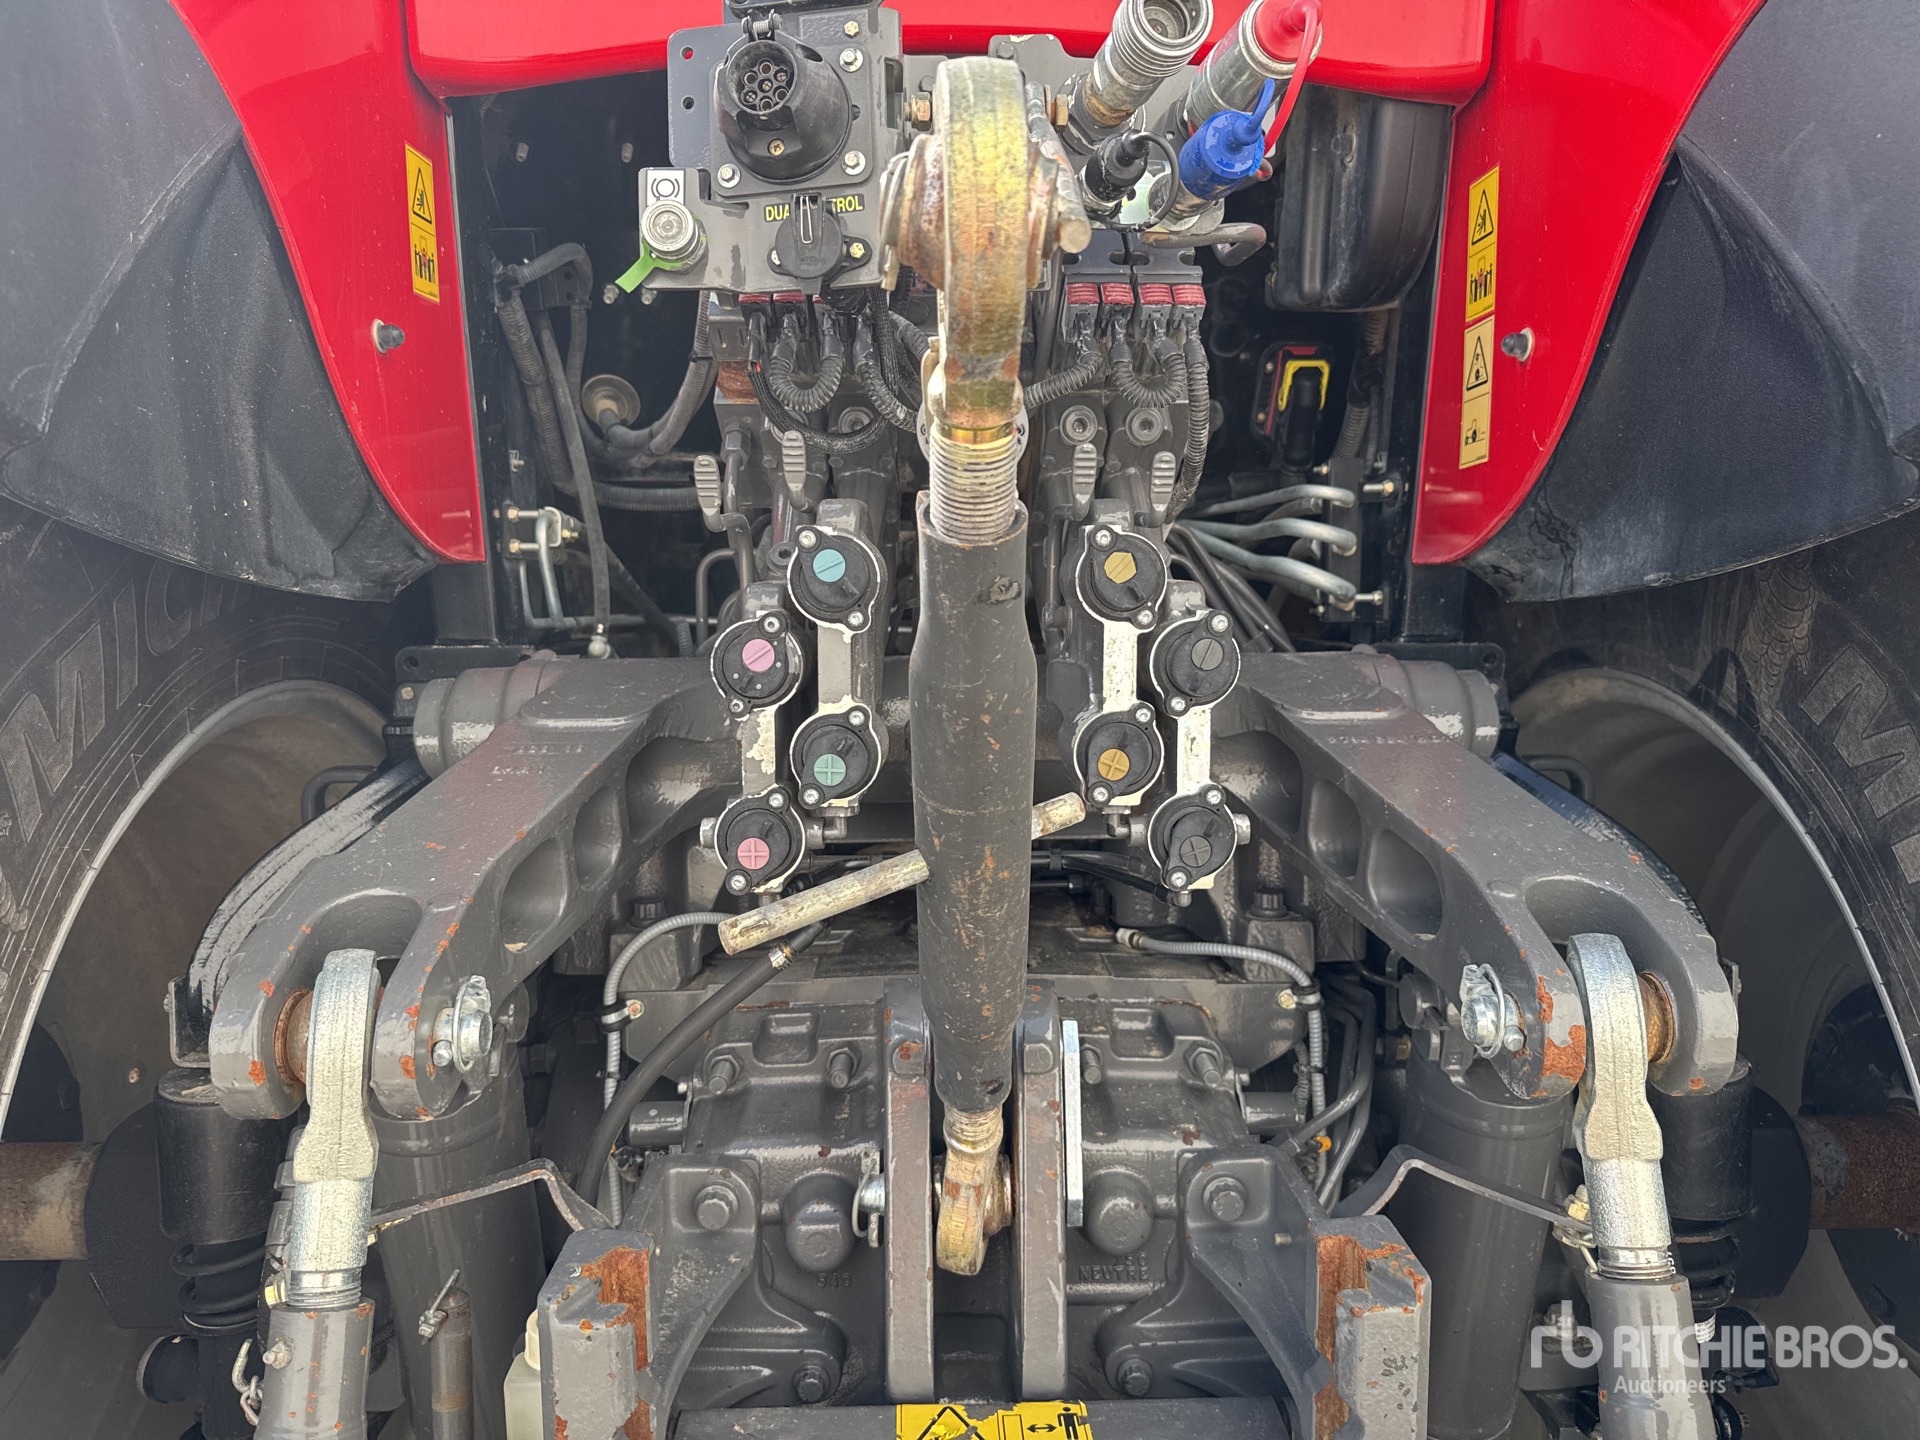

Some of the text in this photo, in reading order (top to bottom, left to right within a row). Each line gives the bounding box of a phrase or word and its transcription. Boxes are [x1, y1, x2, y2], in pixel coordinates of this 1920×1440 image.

[765, 195, 863, 221] DUA TROL
[1079, 1265, 1148, 1281] NEUTRE
